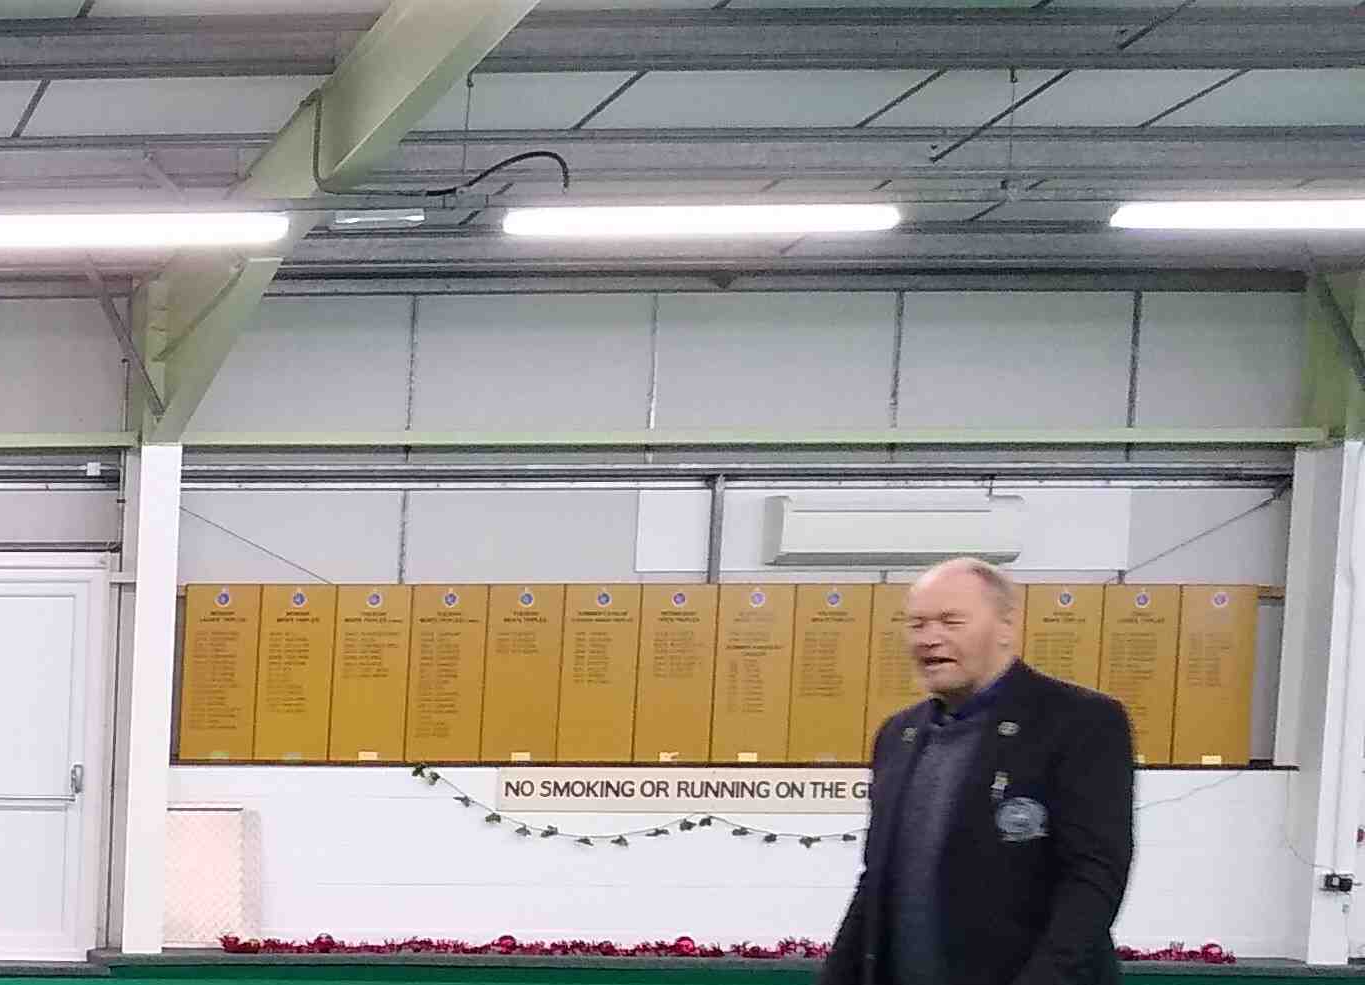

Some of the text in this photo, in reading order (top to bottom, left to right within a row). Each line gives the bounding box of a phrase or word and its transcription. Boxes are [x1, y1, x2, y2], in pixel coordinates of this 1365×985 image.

[504, 780, 535, 798] NO
[539, 780, 636, 798] SMOKING
[639, 780, 669, 798] OR
[676, 780, 771, 799] RUNNING
[774, 780, 805, 799] ON
[809, 780, 847, 799] THE
